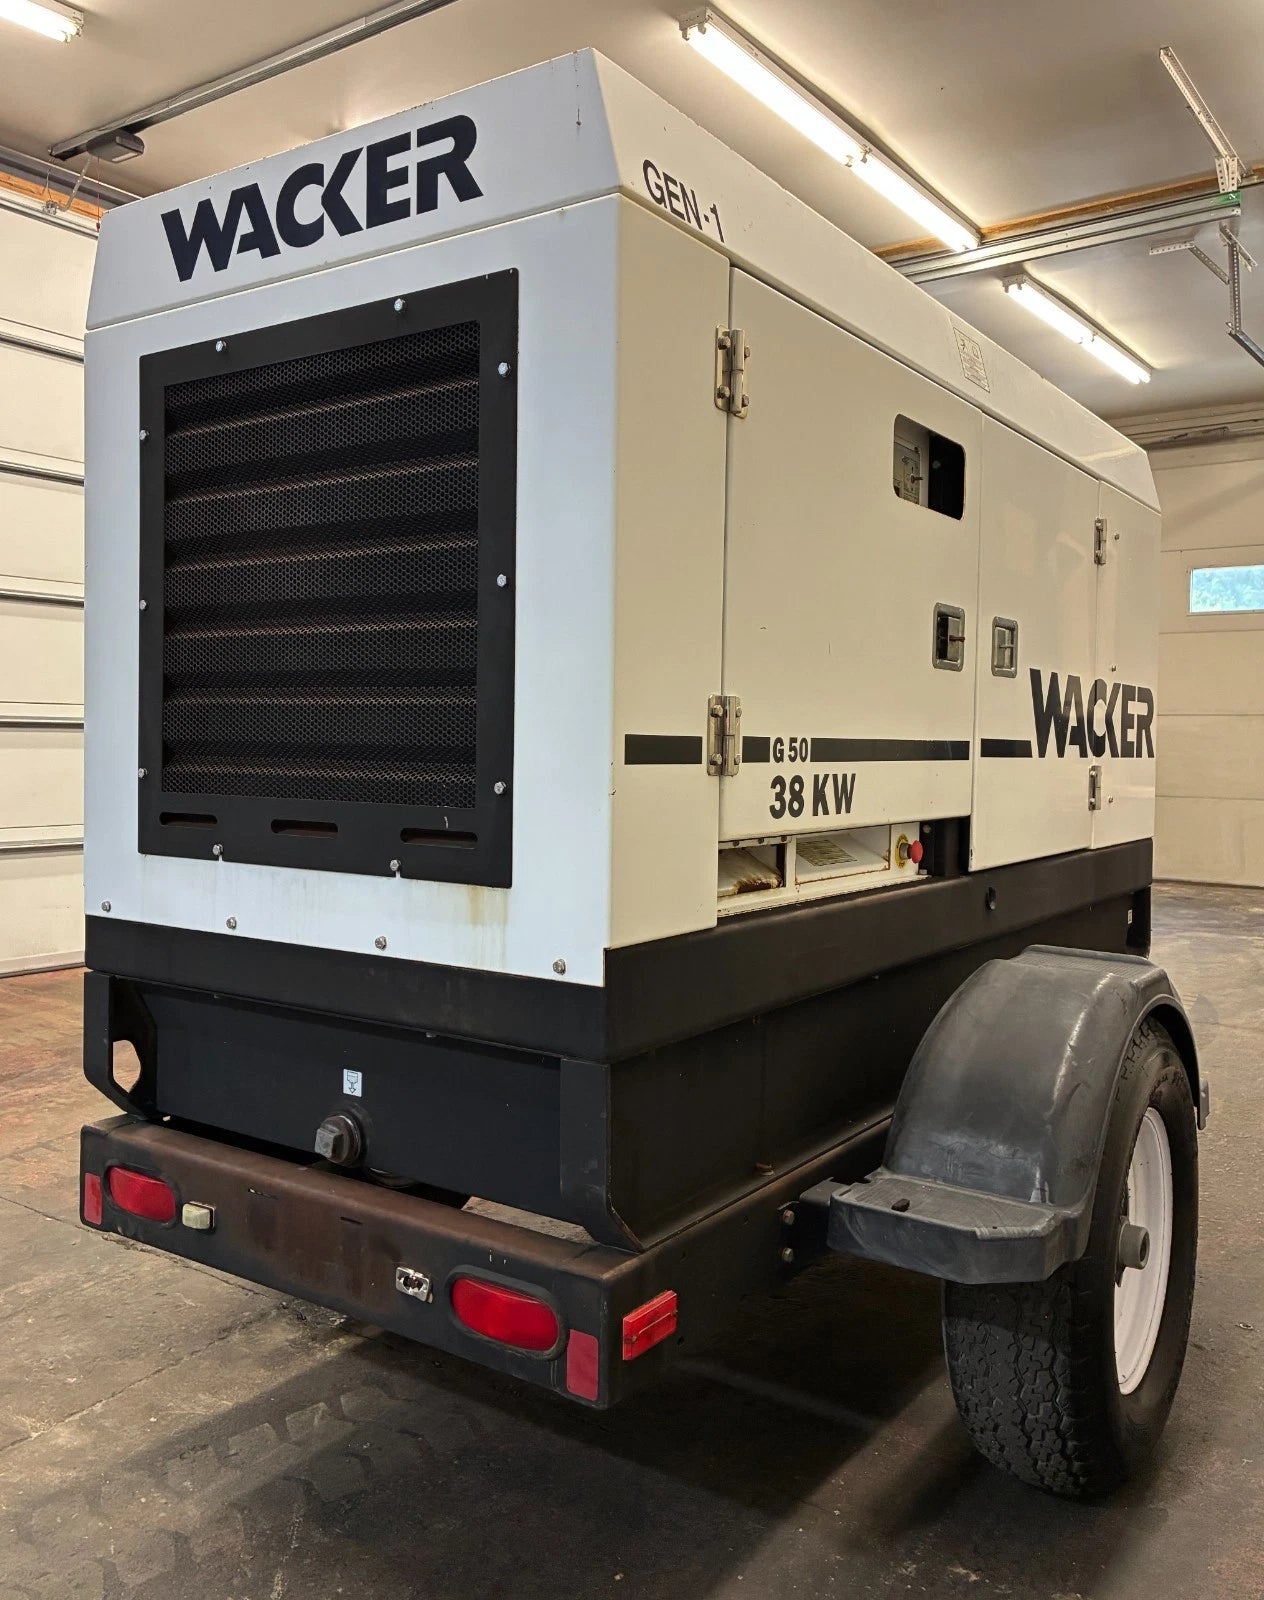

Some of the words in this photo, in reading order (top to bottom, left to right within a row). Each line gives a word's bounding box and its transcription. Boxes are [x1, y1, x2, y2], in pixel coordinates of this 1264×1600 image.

[161, 114, 484, 283] WACKER
[642, 159, 724, 243] GEN-1
[1029, 667, 1155, 759] WACKER
[769, 774, 805, 820] 38
[812, 773, 856, 817] KW
